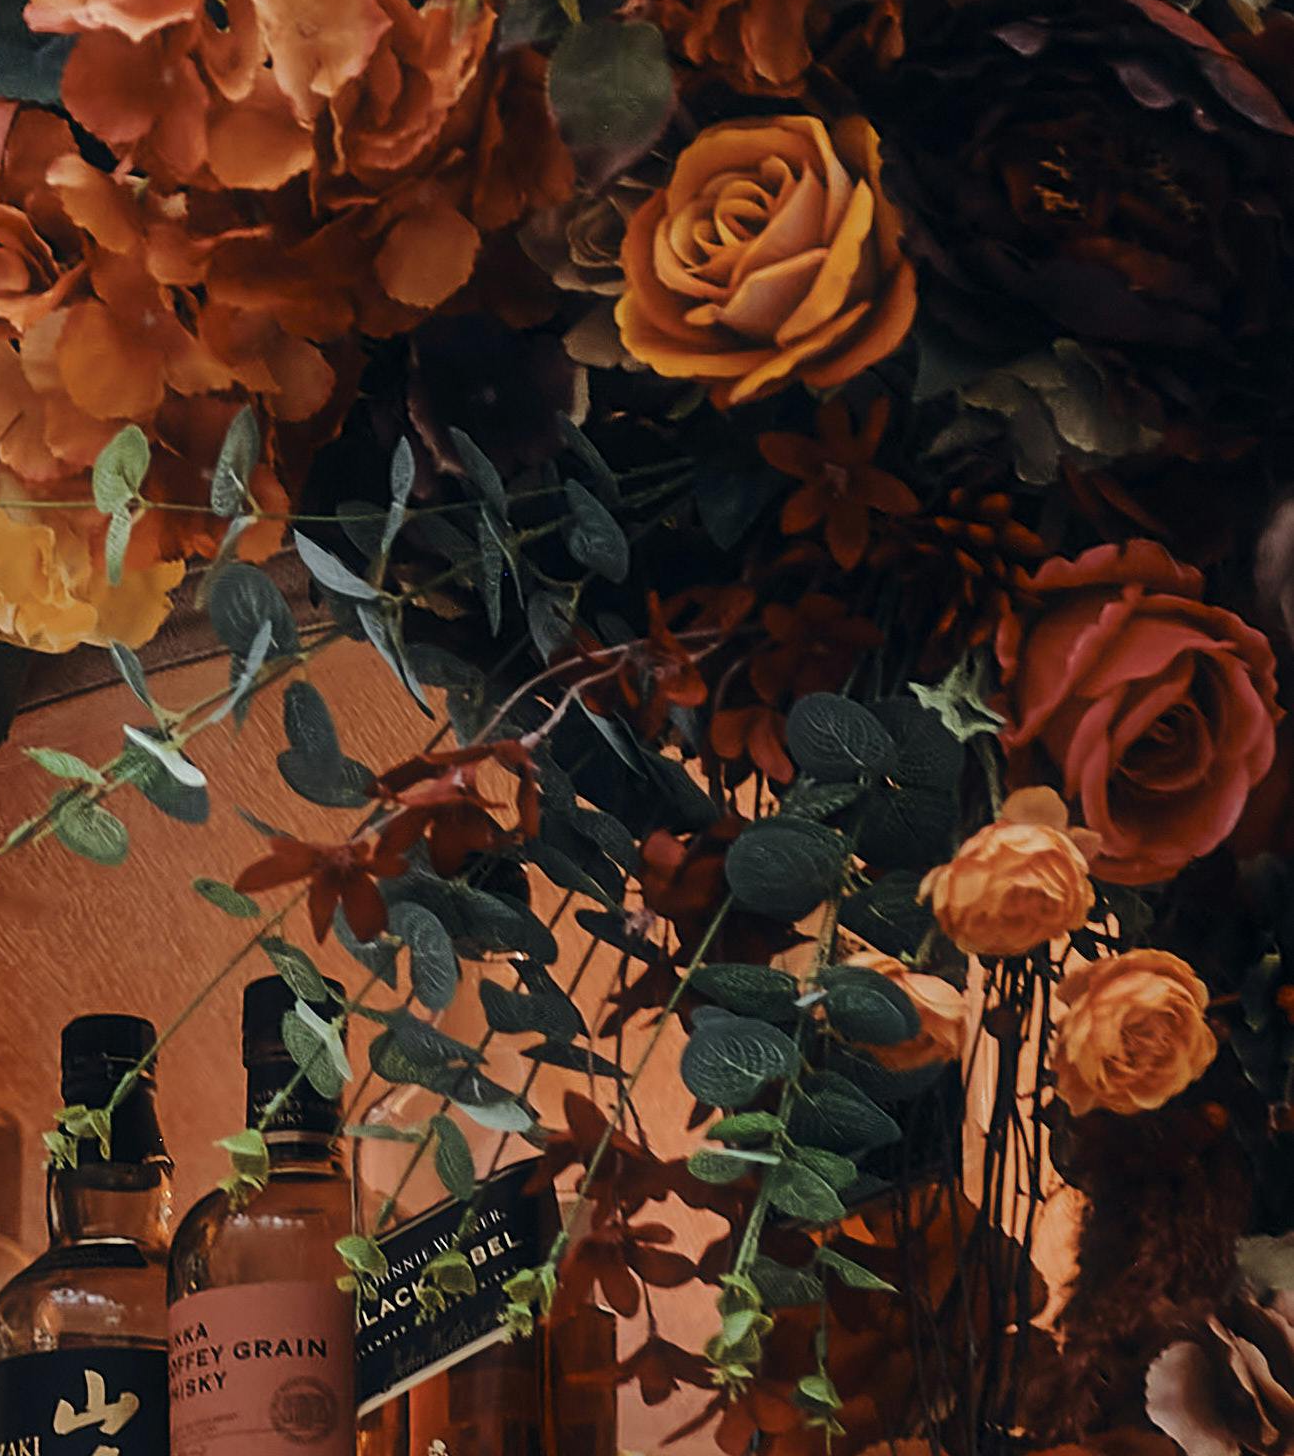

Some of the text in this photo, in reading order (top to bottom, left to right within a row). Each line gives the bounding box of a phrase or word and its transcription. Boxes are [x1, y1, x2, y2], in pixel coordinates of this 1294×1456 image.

[432, 1209, 503, 1253] WAER
[356, 1276, 427, 1331] LACK
[469, 1230, 519, 1266] BEL
[232, 1338, 328, 1360] GRAIN
